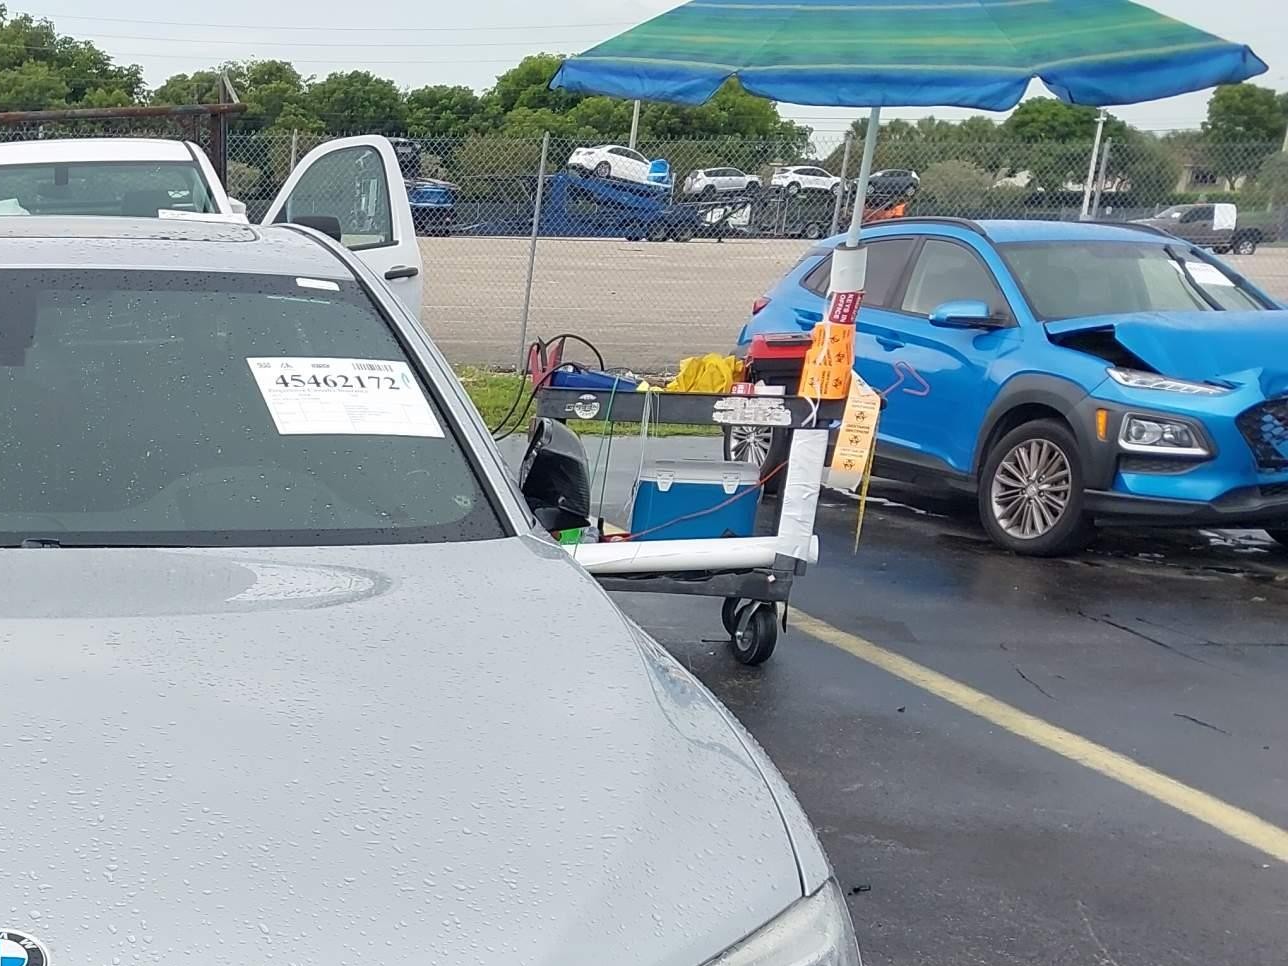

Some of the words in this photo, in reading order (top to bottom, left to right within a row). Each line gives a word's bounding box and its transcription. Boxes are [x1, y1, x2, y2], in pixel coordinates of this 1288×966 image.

[833, 294, 847, 320] OFFICE
[843, 293, 855, 314] KEYS
[840, 314, 848, 323] IN
[275, 374, 400, 390] 45462172
